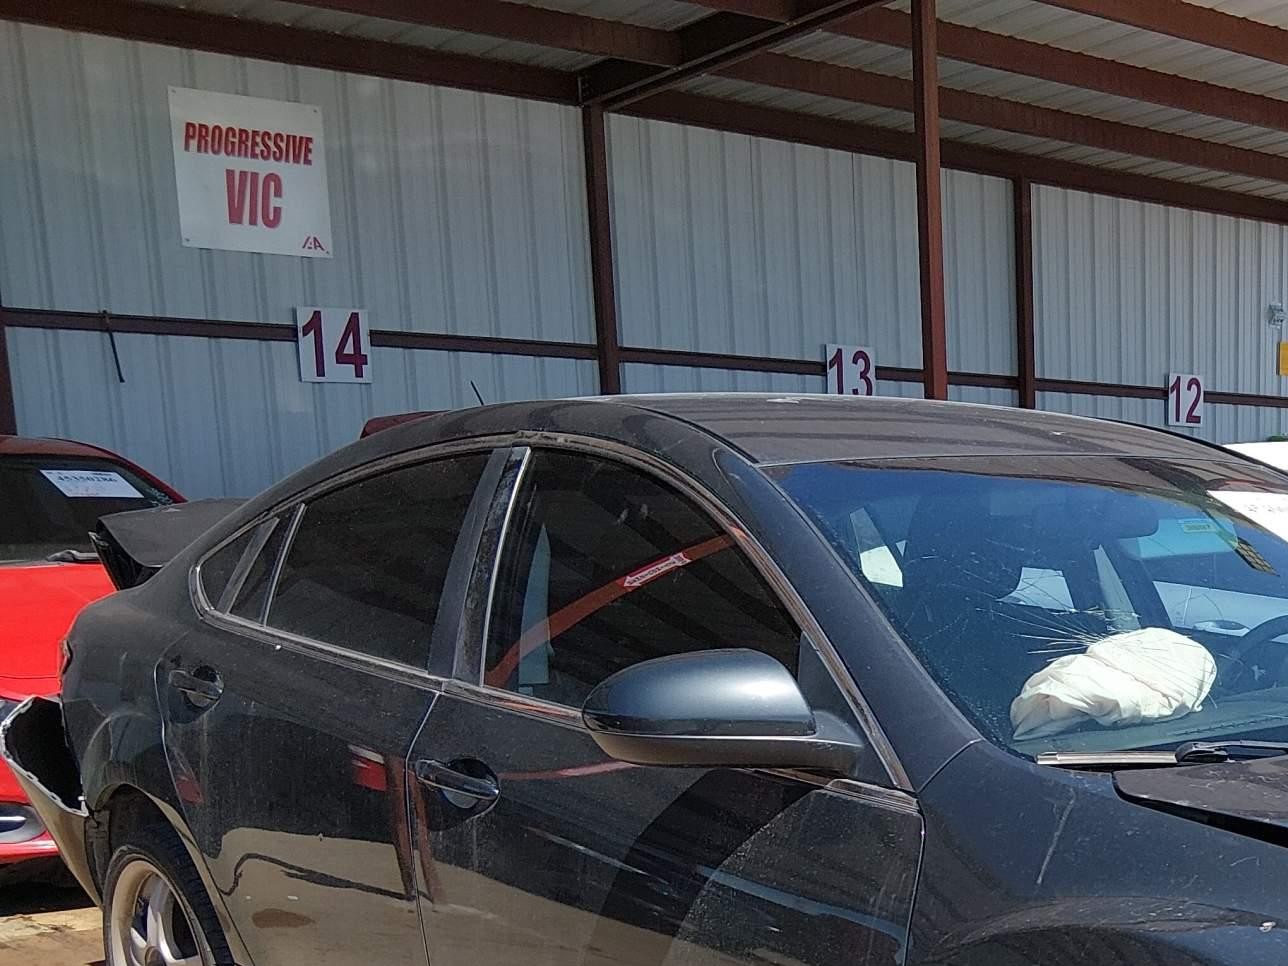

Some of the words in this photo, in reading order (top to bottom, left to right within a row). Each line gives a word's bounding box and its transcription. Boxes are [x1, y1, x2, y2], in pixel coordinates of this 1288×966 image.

[183, 121, 313, 165] PROGRESSIVE
[225, 170, 283, 229] VIC
[301, 310, 368, 378] 14
[829, 350, 873, 395] 13
[1169, 375, 1202, 423] 12
